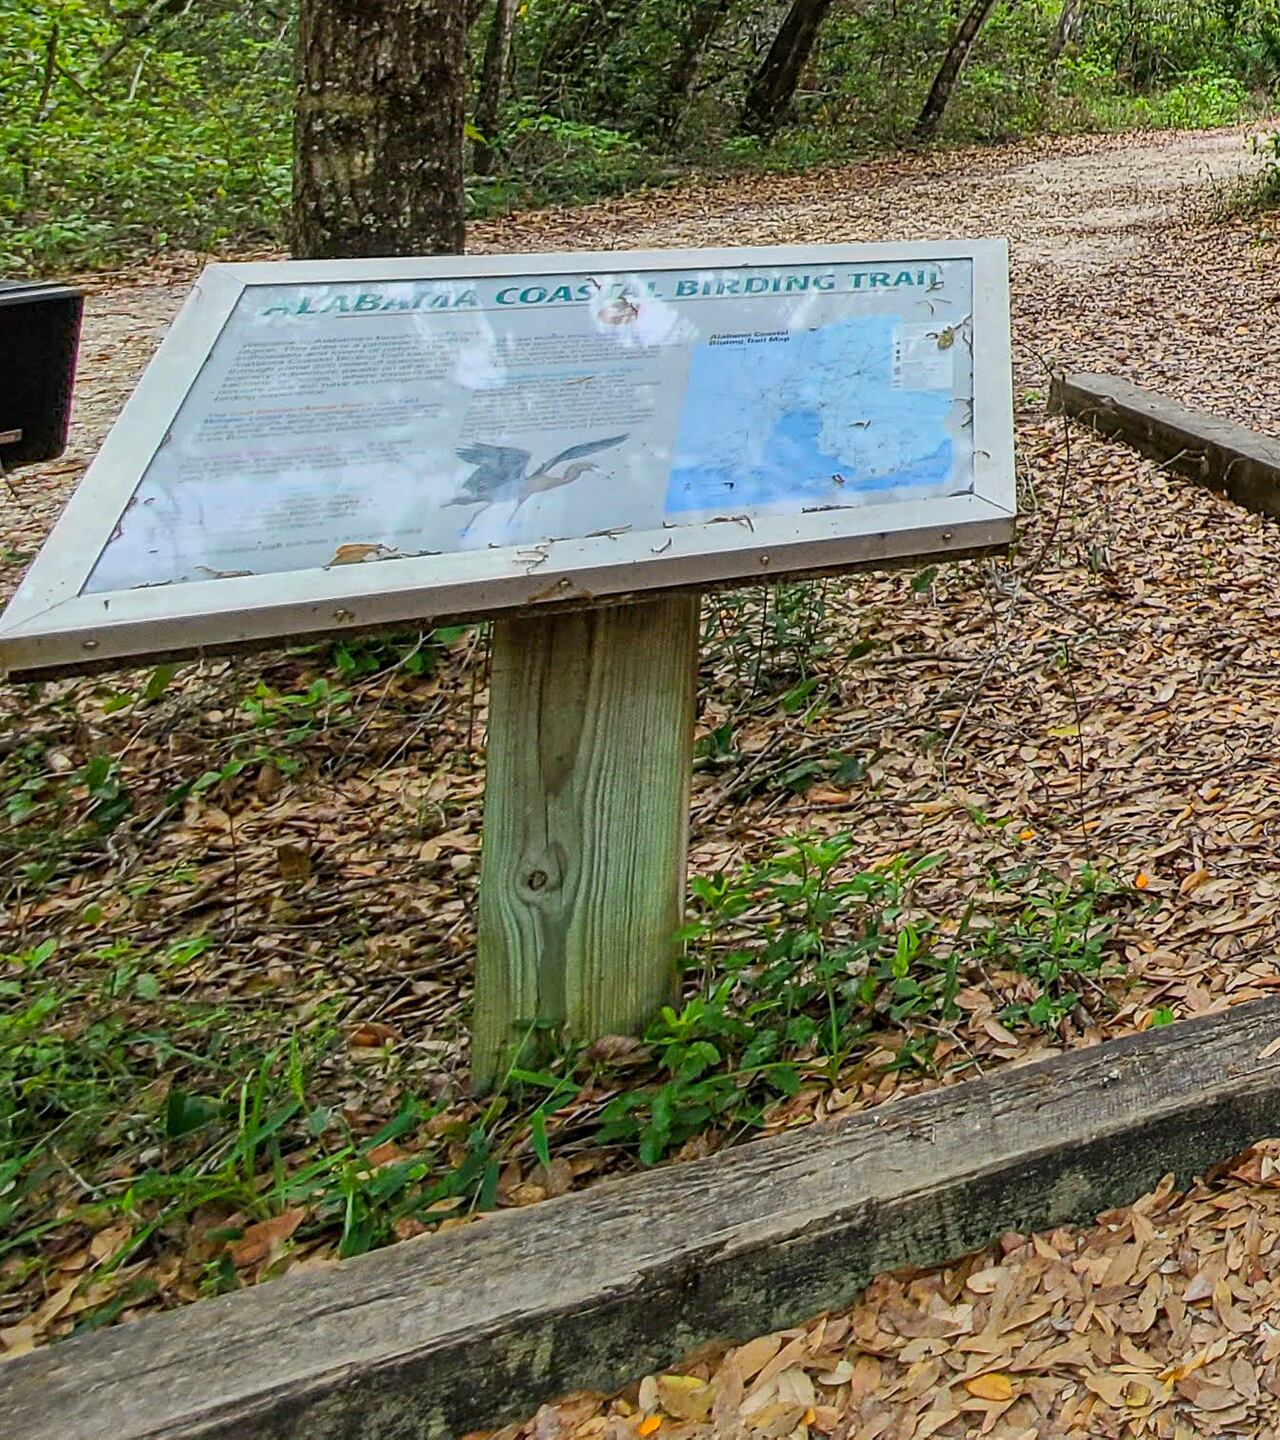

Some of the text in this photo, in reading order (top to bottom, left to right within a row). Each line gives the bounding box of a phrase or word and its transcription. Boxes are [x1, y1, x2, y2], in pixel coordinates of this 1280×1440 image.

[263, 269, 941, 317] ALABAMA COASTAL BIRDING TRAIL
[710, 330, 789, 340] Alabama Coastal
